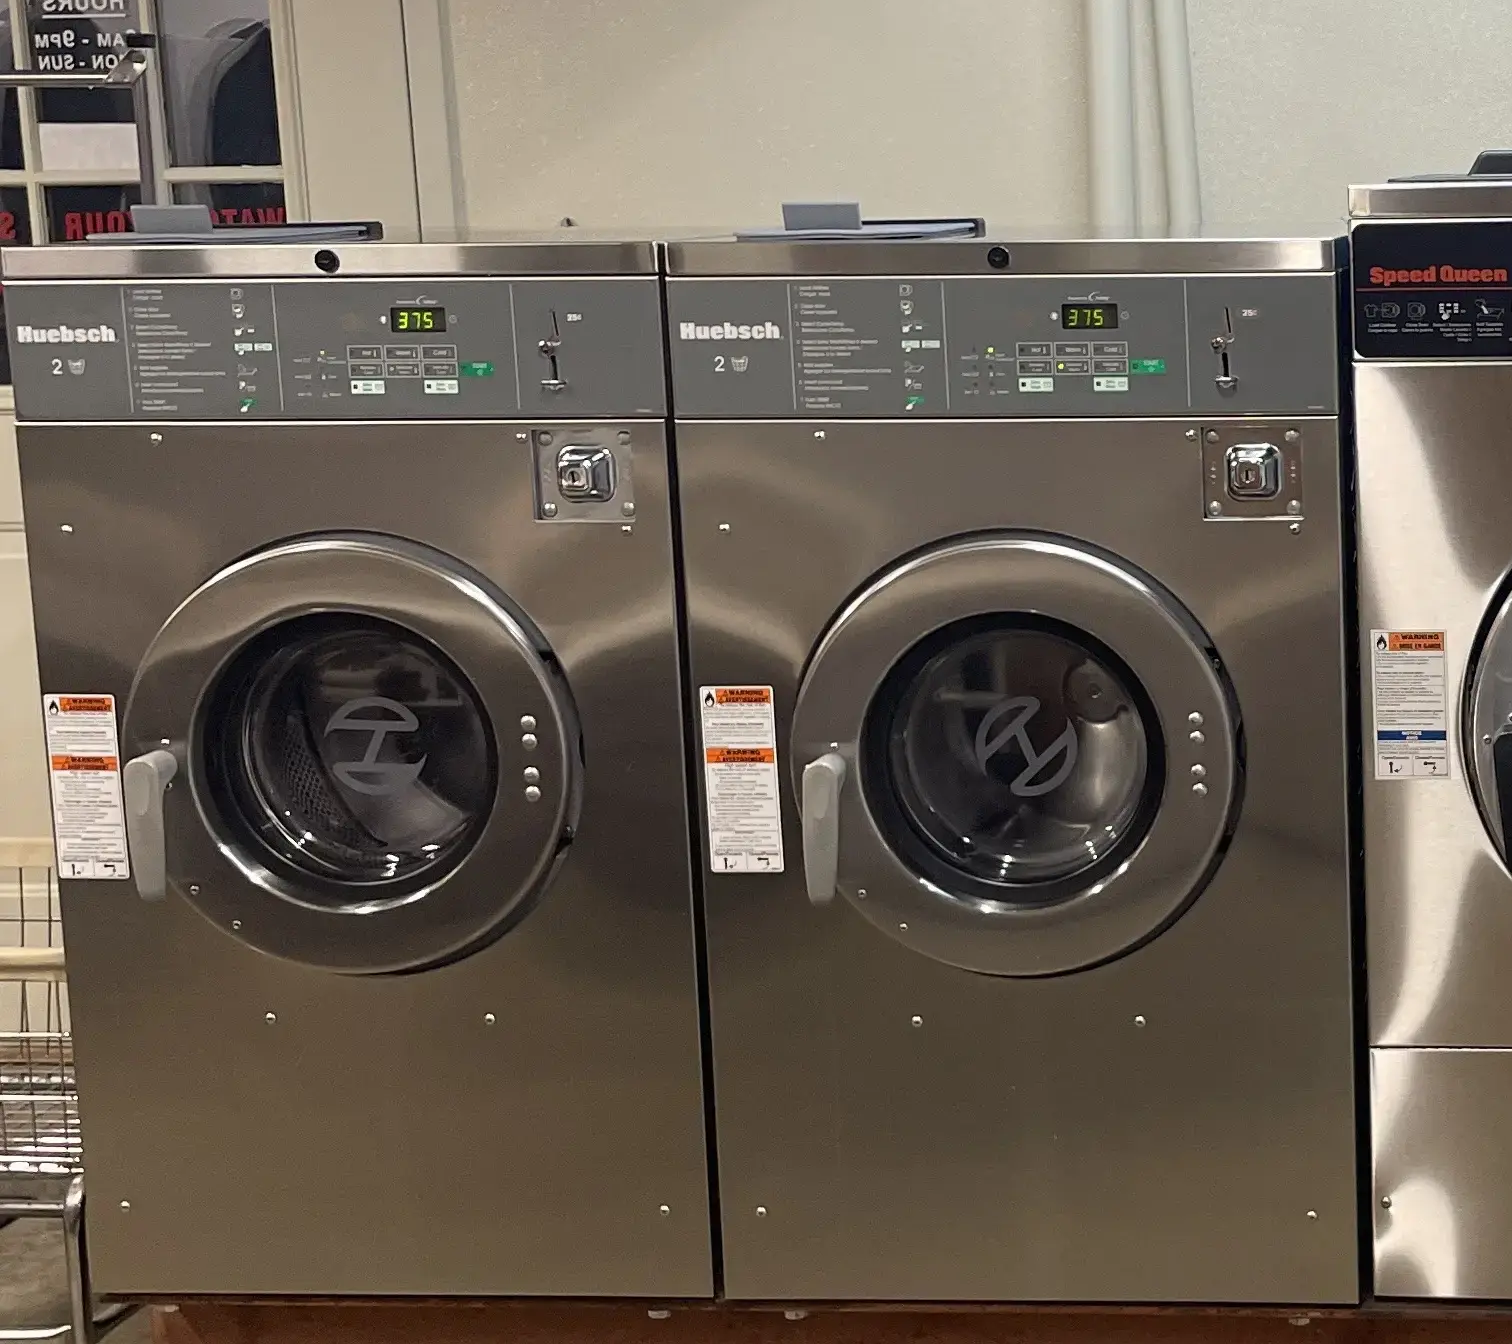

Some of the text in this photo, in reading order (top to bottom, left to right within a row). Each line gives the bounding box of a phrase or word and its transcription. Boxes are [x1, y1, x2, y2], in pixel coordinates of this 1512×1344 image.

[1369, 263, 1509, 287] Speed Queen
[397, 311, 434, 330] 375
[1067, 308, 1105, 327] 375
[16, 324, 116, 344] Huebsch
[679, 320, 781, 340] Huebsch
[51, 358, 64, 376] 2
[713, 355, 726, 373] 2
